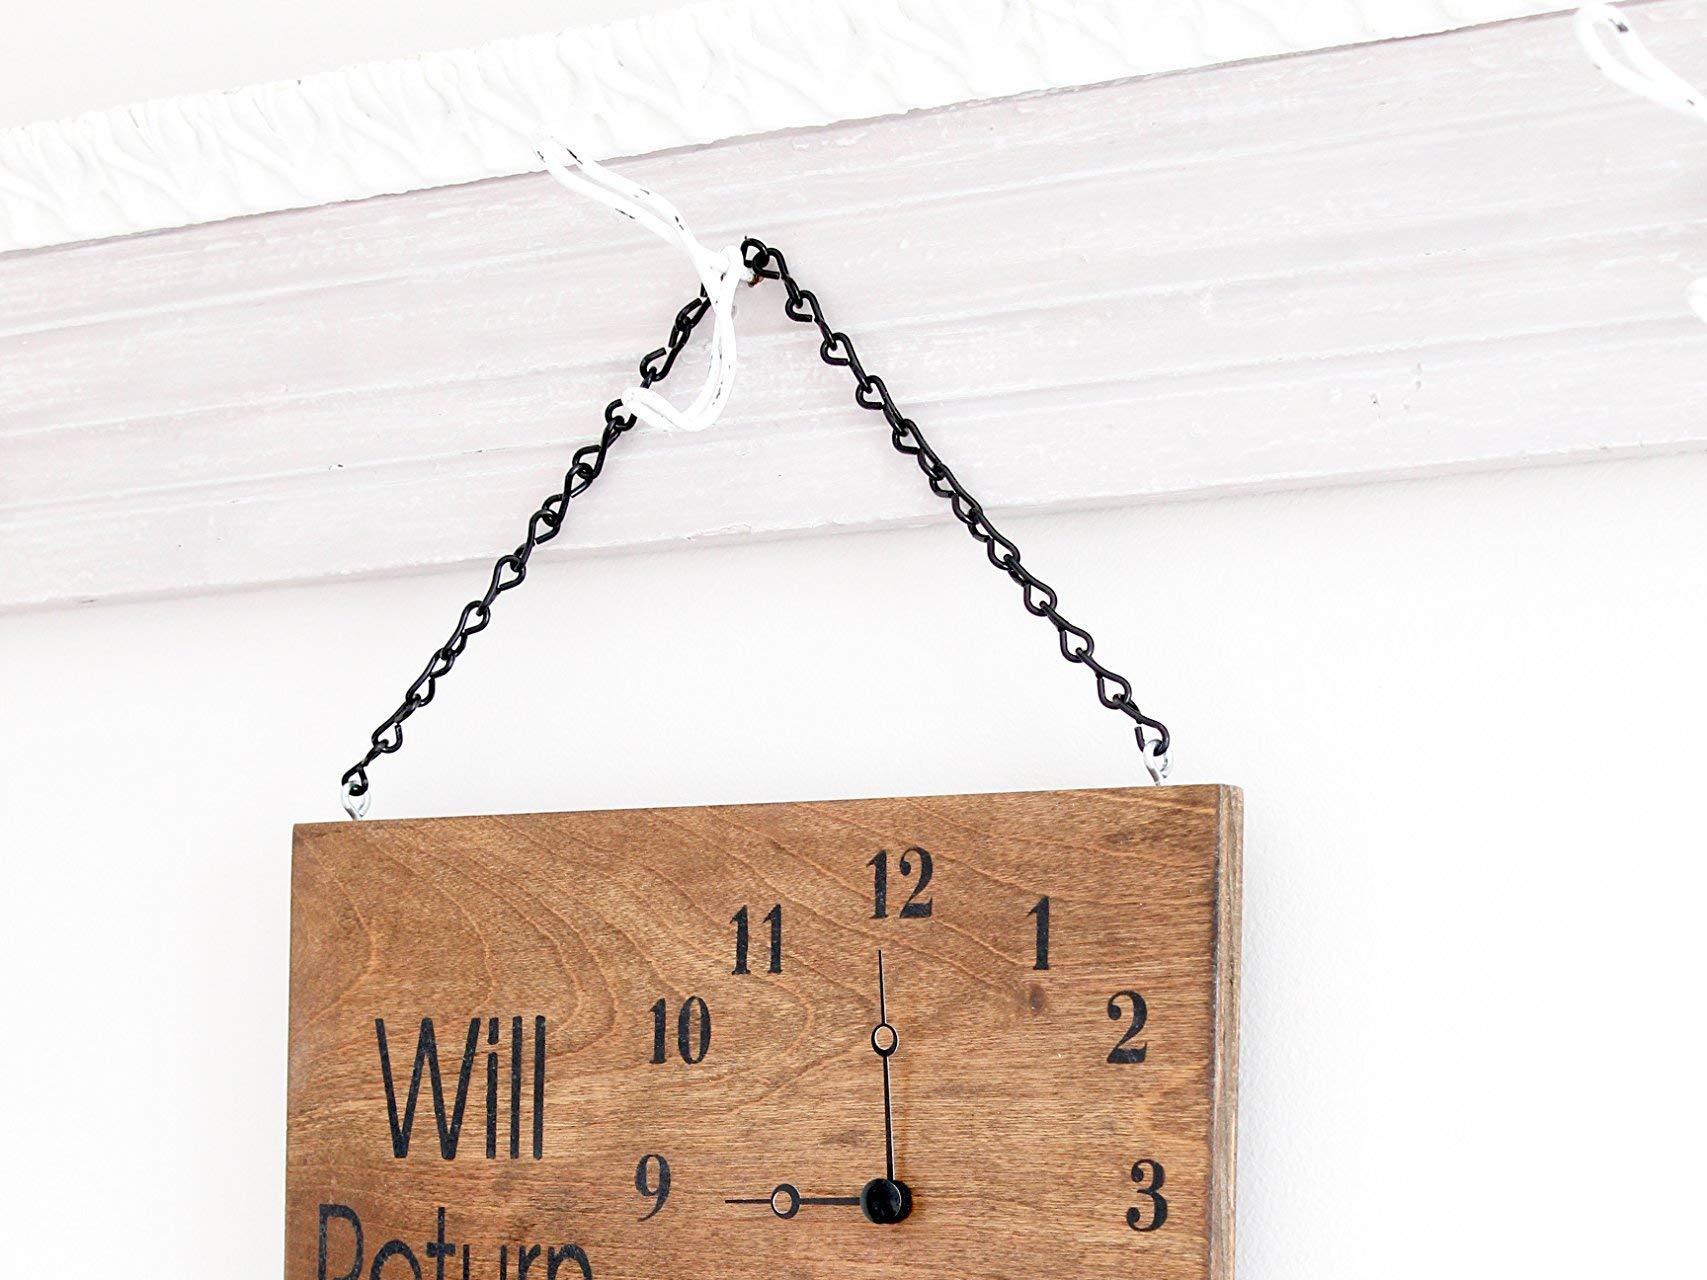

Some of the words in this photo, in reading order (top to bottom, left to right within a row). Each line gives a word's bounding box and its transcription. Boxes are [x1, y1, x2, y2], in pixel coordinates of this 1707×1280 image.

[866, 846, 933, 919] 12
[730, 904, 783, 975] 11
[1027, 896, 1050, 971] 1
[649, 995, 711, 1065] 10
[1107, 990, 1148, 1064] 2
[376, 1014, 546, 1161] Will
[634, 1153, 671, 1222] 9
[1127, 1159, 1168, 1232] 3
